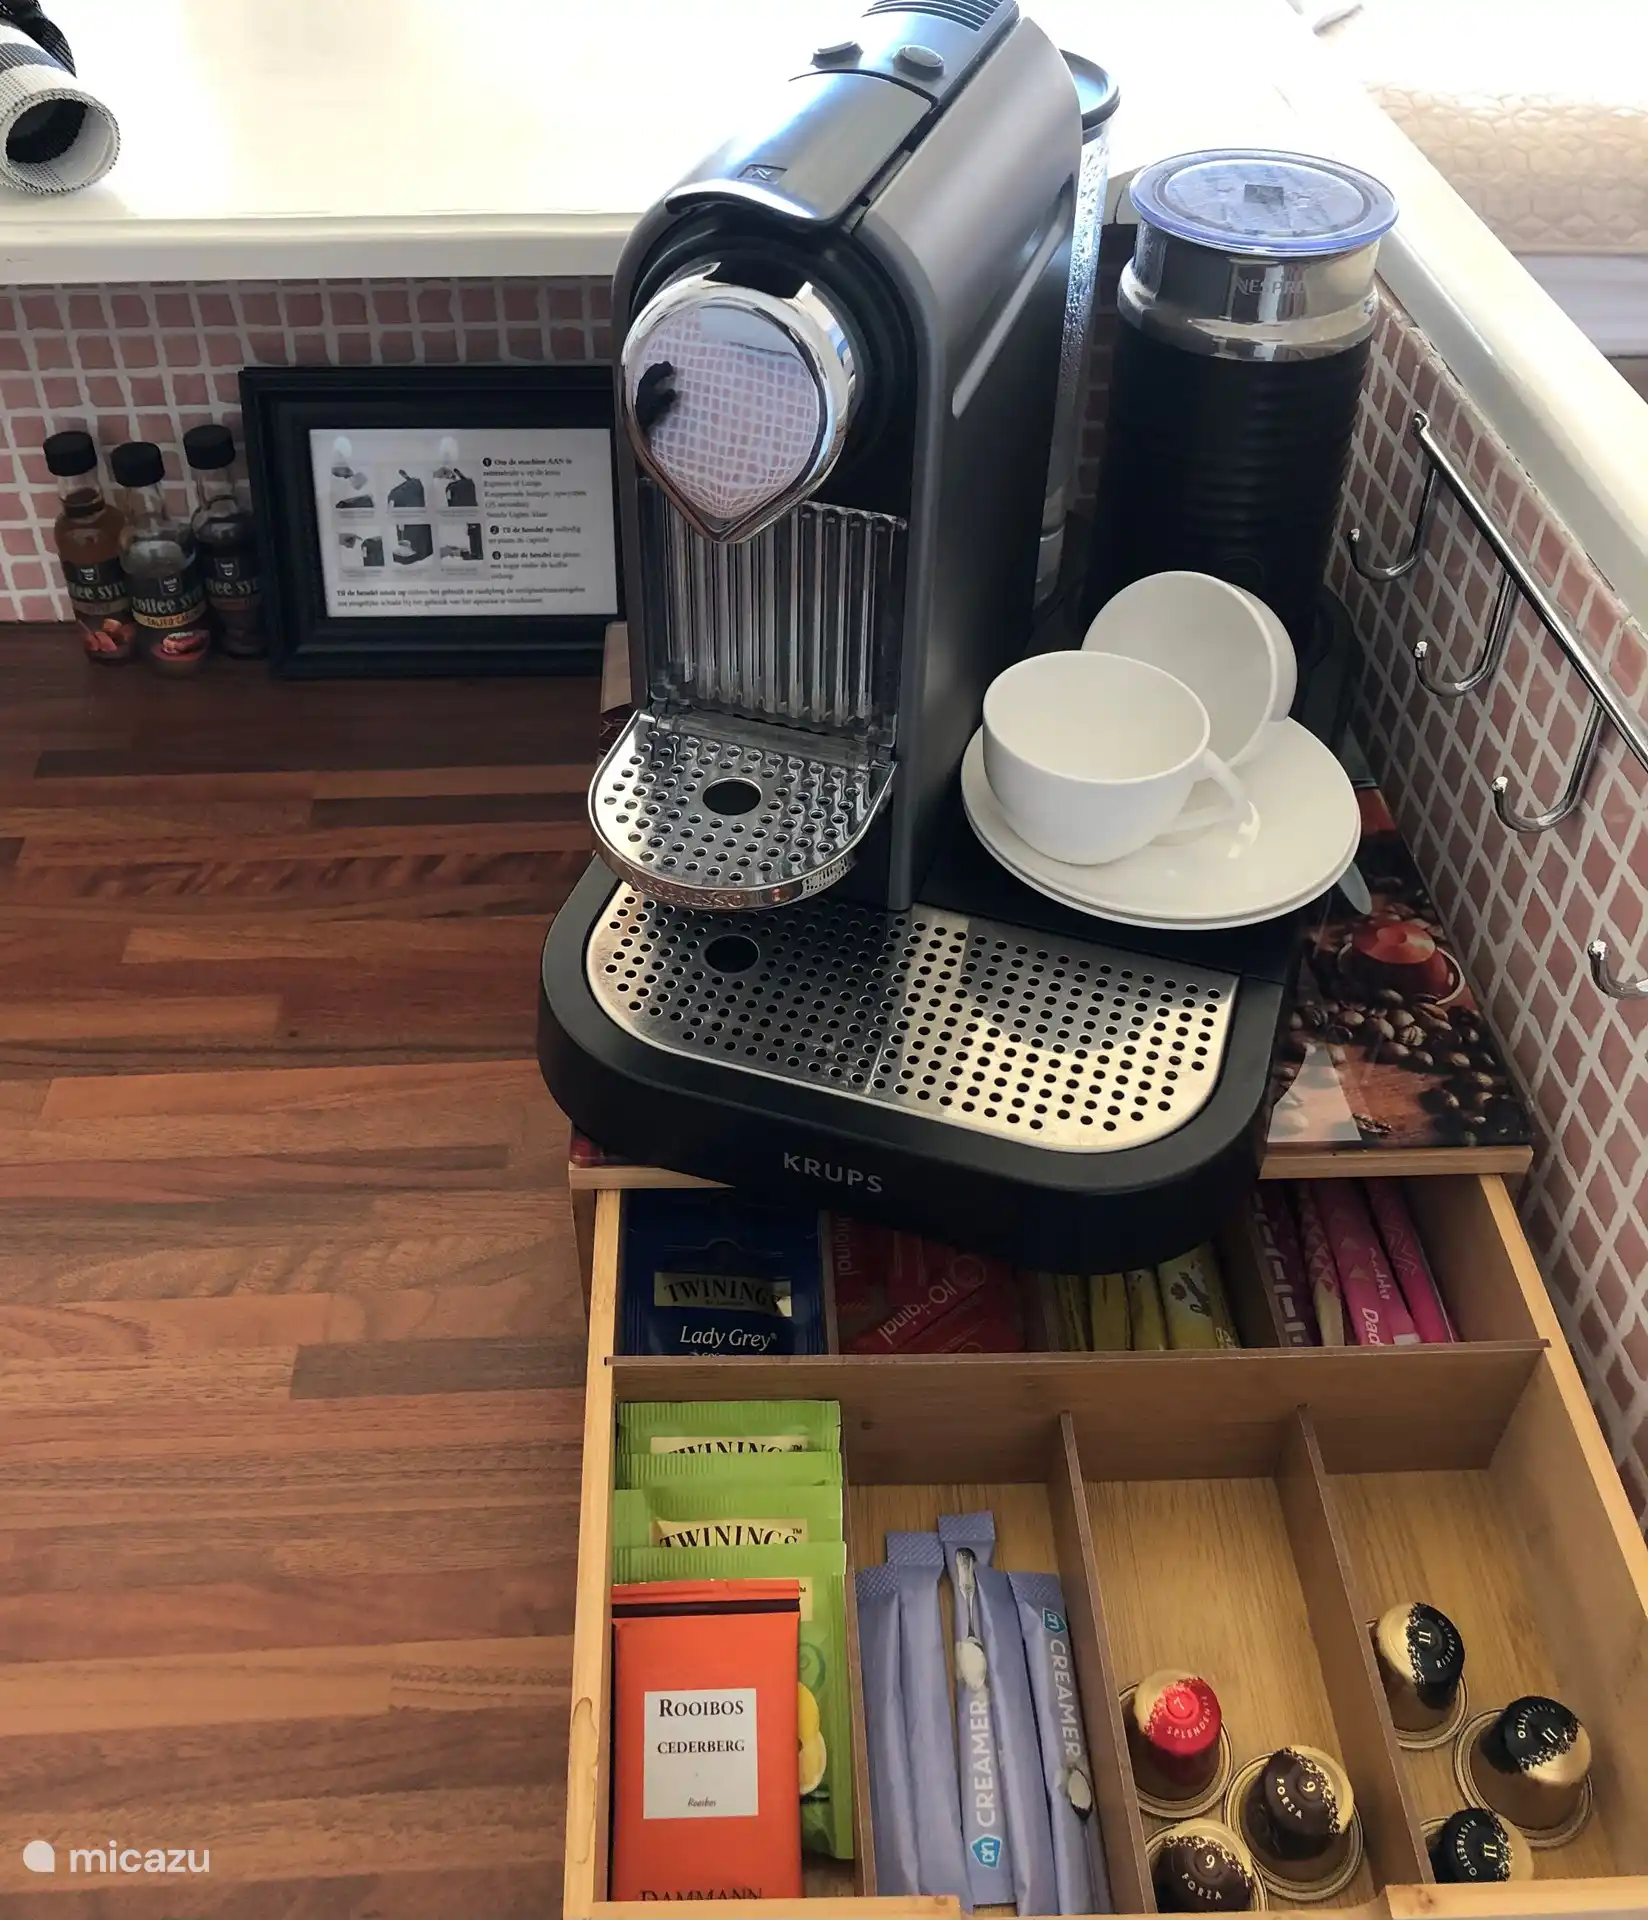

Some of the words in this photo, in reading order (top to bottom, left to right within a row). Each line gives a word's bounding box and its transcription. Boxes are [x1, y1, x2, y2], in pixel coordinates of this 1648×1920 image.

[783, 1151, 884, 1194] KRUPS
[679, 1325, 725, 1349] Lady
[1049, 1637, 1082, 1759] CREAMER
[1173, 1696, 1185, 1711] 7
[657, 1738, 746, 1755] CEDERBERG
[970, 1697, 996, 1828] CREAMER
[687, 1796, 717, 1808] Rooibos
[1276, 1777, 1303, 1820] FORZA
[1204, 1854, 1215, 1869] 9
[1456, 1819, 1478, 1876] RISTRETTO
[1181, 1872, 1223, 1901] FORZA
